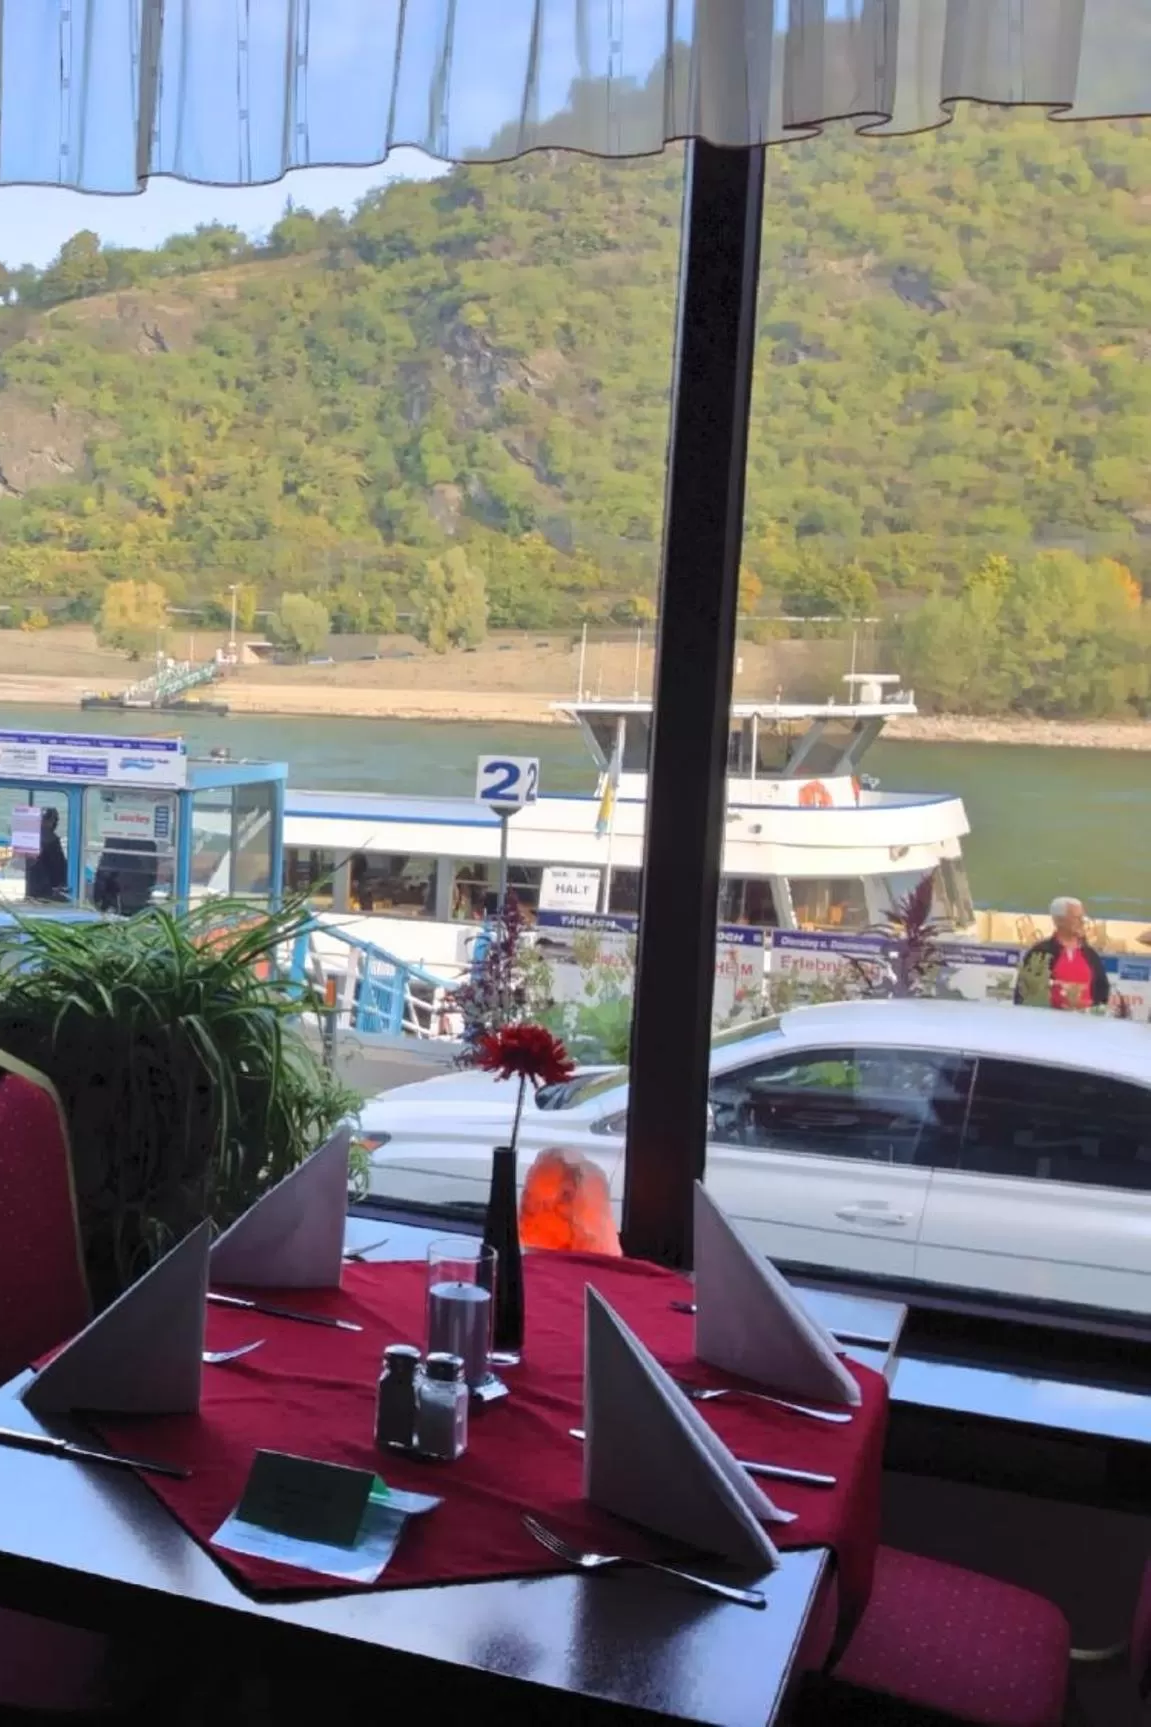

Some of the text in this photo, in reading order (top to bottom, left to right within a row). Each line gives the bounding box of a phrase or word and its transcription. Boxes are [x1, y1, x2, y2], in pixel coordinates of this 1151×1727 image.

[480, 761, 521, 801] 2
[525, 762, 538, 802] 2
[555, 882, 591, 896] HALT
